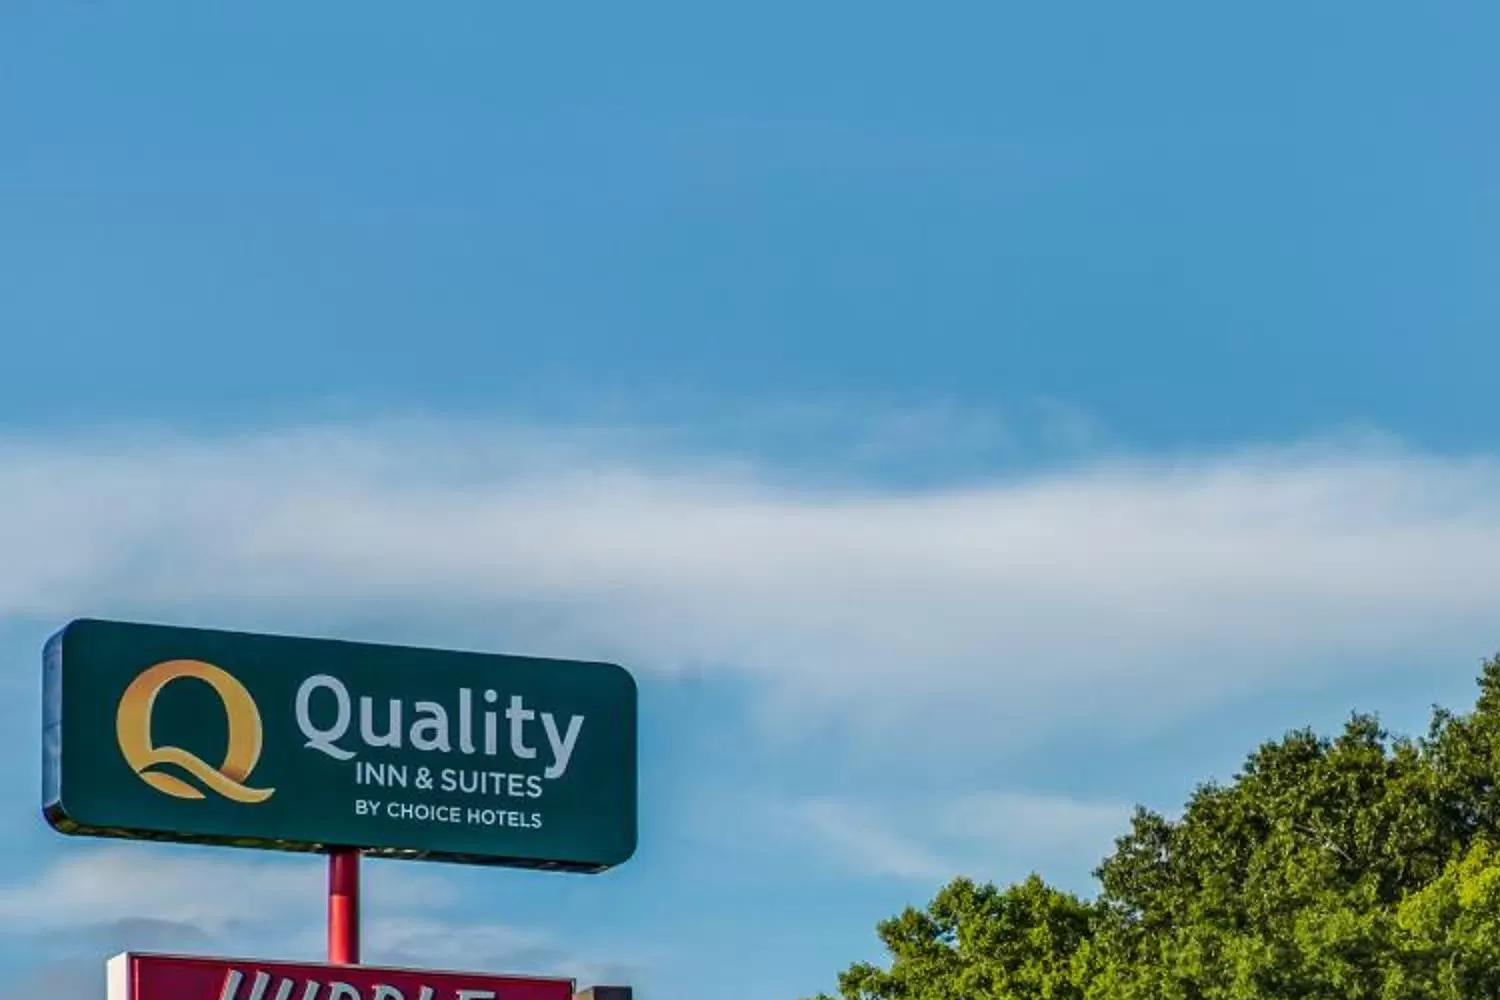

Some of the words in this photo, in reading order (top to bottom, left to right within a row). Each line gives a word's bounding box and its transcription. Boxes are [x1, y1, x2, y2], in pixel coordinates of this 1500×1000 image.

[116, 659, 275, 803] Q
[295, 674, 585, 779] Quality
[355, 761, 407, 787] INN
[414, 766, 434, 790] &
[441, 768, 543, 798] SUITES
[355, 799, 382, 816] BY
[386, 801, 462, 823] CHOICE
[467, 808, 543, 829] HOTELS
